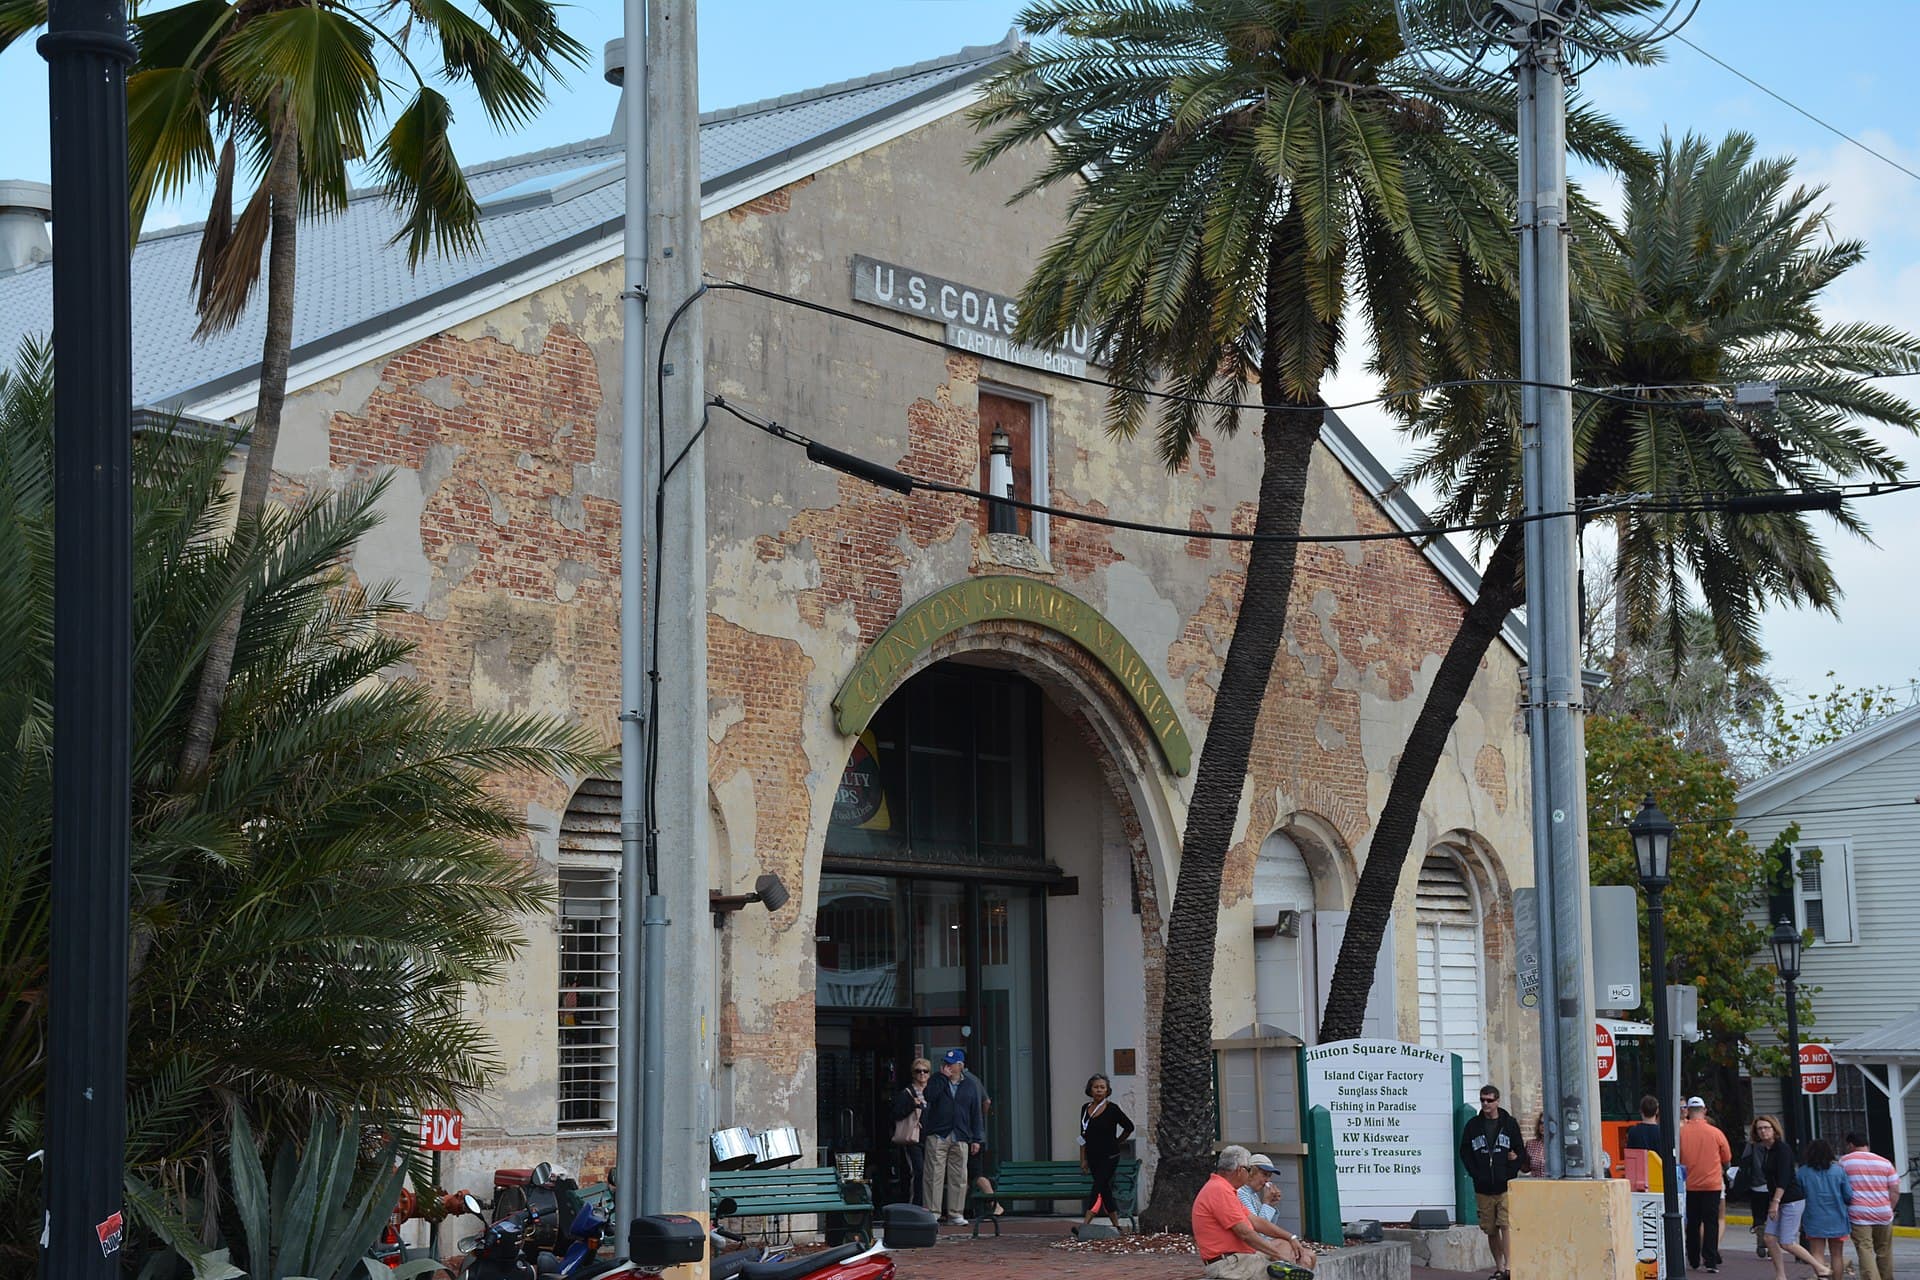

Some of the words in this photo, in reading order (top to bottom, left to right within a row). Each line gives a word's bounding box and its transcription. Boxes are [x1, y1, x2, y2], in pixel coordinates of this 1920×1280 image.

[957, 329, 1019, 362] CAPTAIN
[1043, 353, 1077, 377] PORT
[857, 588, 968, 704] CLINTON
[983, 583, 1078, 632] SQUARE
[1092, 620, 1180, 738] MARKET
[1353, 1043, 1397, 1057] Square
[1401, 1045, 1445, 1064] Market
[1812, 1054, 1828, 1063] NOT
[1324, 1070, 1355, 1080] Island
[1358, 1070, 1384, 1082] Cigar
[1387, 1070, 1424, 1082] Factory
[1802, 1075, 1827, 1085] ENTER
[1338, 1086, 1378, 1097] Sunglass
[1380, 1086, 1408, 1096] Shack
[1330, 1101, 1363, 1113] Fishing
[1366, 1101, 1375, 1111] in
[1378, 1101, 1416, 1111] Paradise
[1347, 1117, 1362, 1127] 3-D
[1364, 1117, 1384, 1127] Mini
[1387, 1117, 1400, 1127] Me
[420, 1114, 460, 1145] FDC
[1343, 1132, 1360, 1142] KW
[1363, 1132, 1409, 1143] Kidswear
[1334, 1147, 1369, 1156] ature's
[1371, 1147, 1422, 1157] Treasures
[1357, 1163, 1370, 1174] Fit
[1373, 1163, 1390, 1174] Toe
[1393, 1163, 1421, 1175] Rings
[1636, 1200, 1657, 1264] CITIZEN
